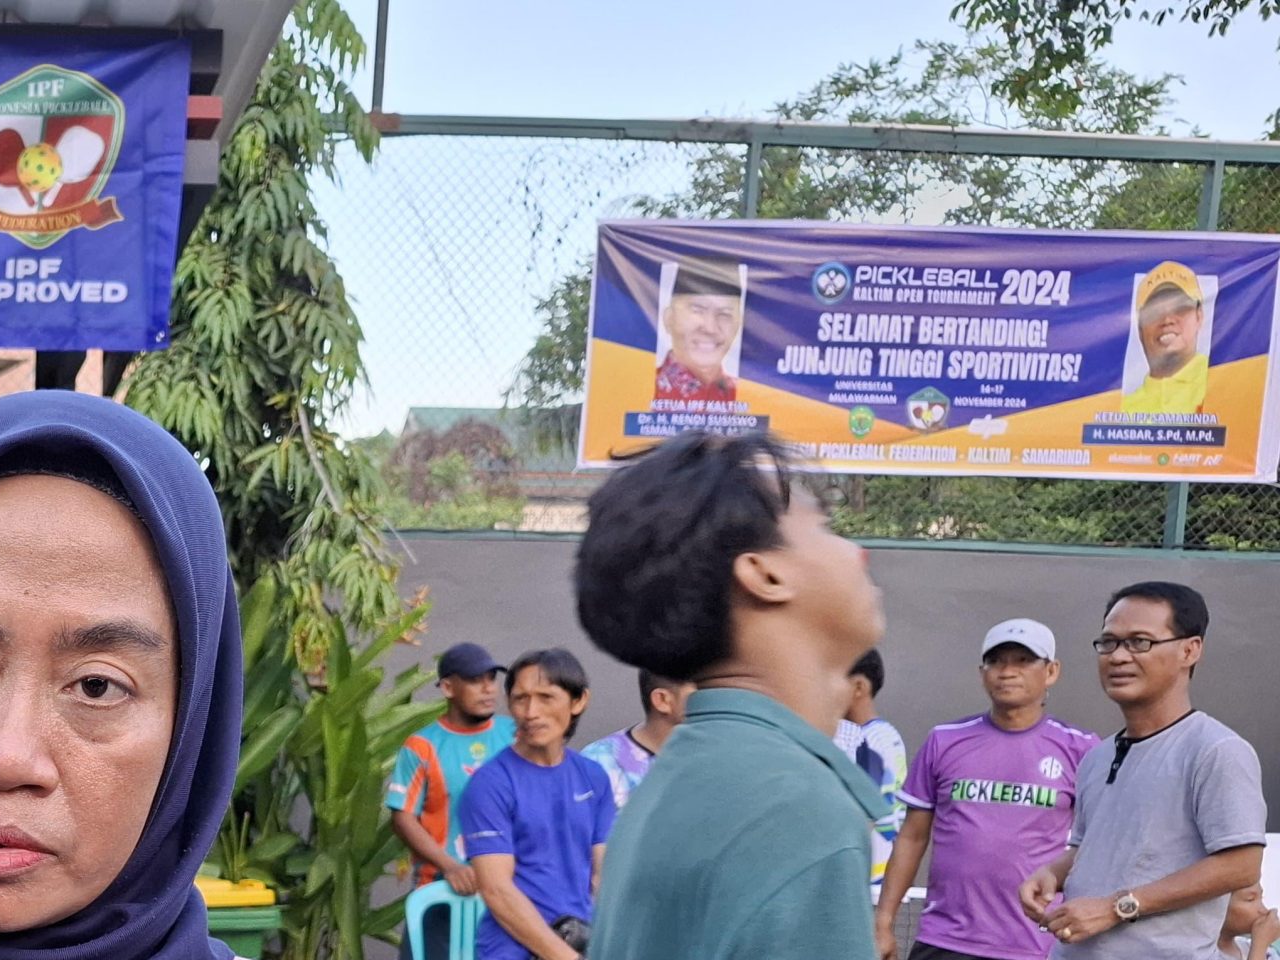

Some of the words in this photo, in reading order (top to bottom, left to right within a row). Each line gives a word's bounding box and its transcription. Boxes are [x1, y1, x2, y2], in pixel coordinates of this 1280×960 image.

[27, 79, 65, 97] IPF
[5, 258, 62, 279] IPF
[855, 265, 999, 289] PICKLEBALL
[1000, 269, 1071, 306] 2024
[853, 287, 894, 301] KALTIM
[896, 289, 924, 303] OPEN
[927, 290, 997, 305] TOURNAMENT
[818, 312, 915, 344] SELAMAT
[918, 315, 1049, 347] BERTANDING!
[777, 346, 874, 376] JUNJUNG
[879, 349, 944, 379] TINGGI
[948, 353, 1083, 382] SPORTIVITAS!
[834, 380, 893, 392] UNIVERSITAS
[650, 400, 685, 411] KETUA
[829, 393, 897, 405] MULAWARMAN
[954, 397, 1003, 408] NOVEMBER
[1095, 412, 1129, 422] KETUA
[1151, 413, 1218, 424] SAMARINDA
[1093, 429, 1104, 439] H.
[1107, 429, 1154, 441] HASBAR,
[1157, 430, 1183, 443] S.Pd,
[1185, 430, 1215, 442] M.Pd.
[819, 443, 885, 460] PICKLEBALL
[888, 445, 956, 463] FEDERATION
[968, 447, 1011, 464] KALTIM
[1022, 448, 1090, 466] SAMARINDA
[951, 781, 1055, 808] PICKLEBALL
